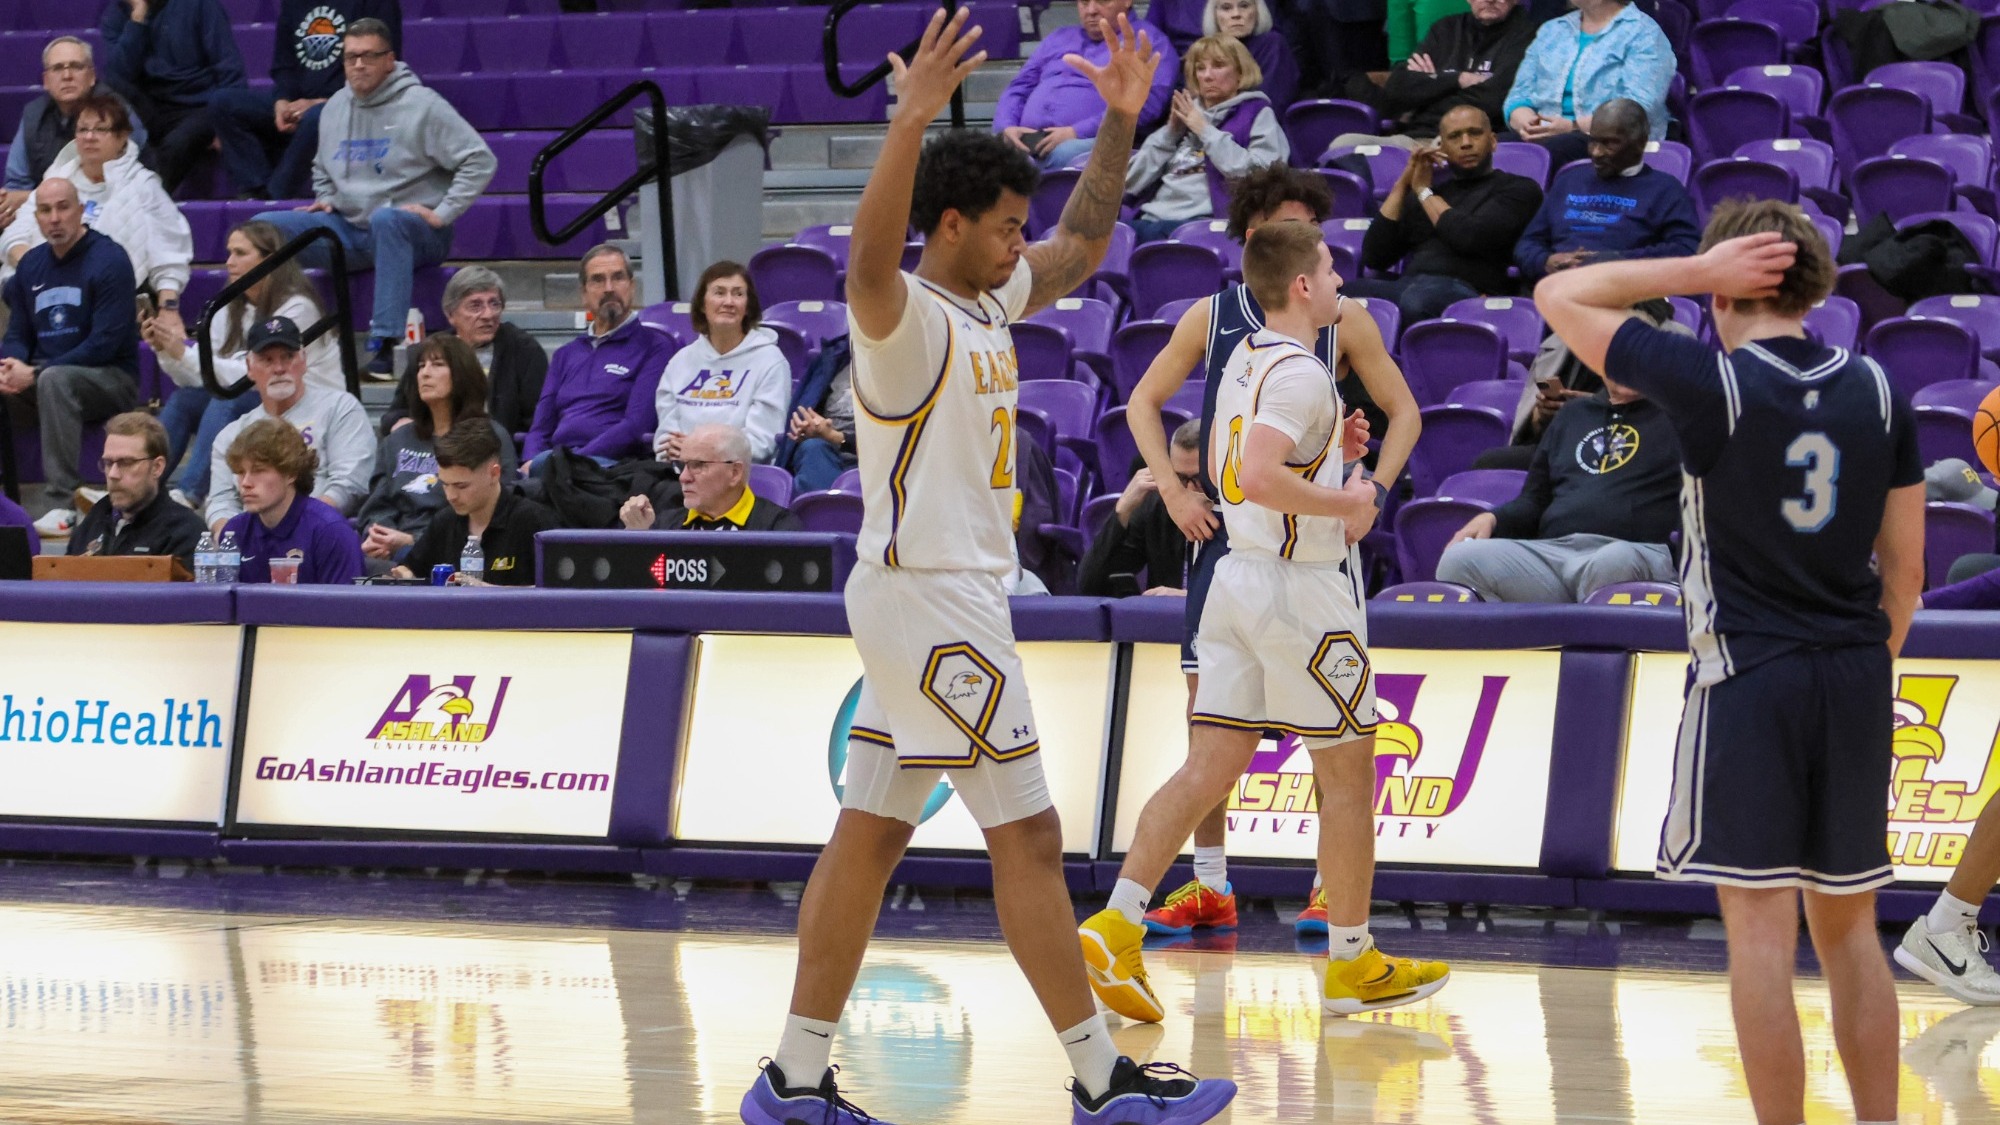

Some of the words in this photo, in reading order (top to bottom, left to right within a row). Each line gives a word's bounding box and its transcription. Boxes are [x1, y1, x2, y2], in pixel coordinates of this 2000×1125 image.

[1781, 431, 1840, 533] 3
[665, 558, 708, 582] POSS
[0, 694, 223, 748] hioHealth
[375, 721, 488, 743] ASHLAND
[373, 742, 480, 752] UNIVERSITY
[256, 757, 610, 794] GoAshlandEagles.com
